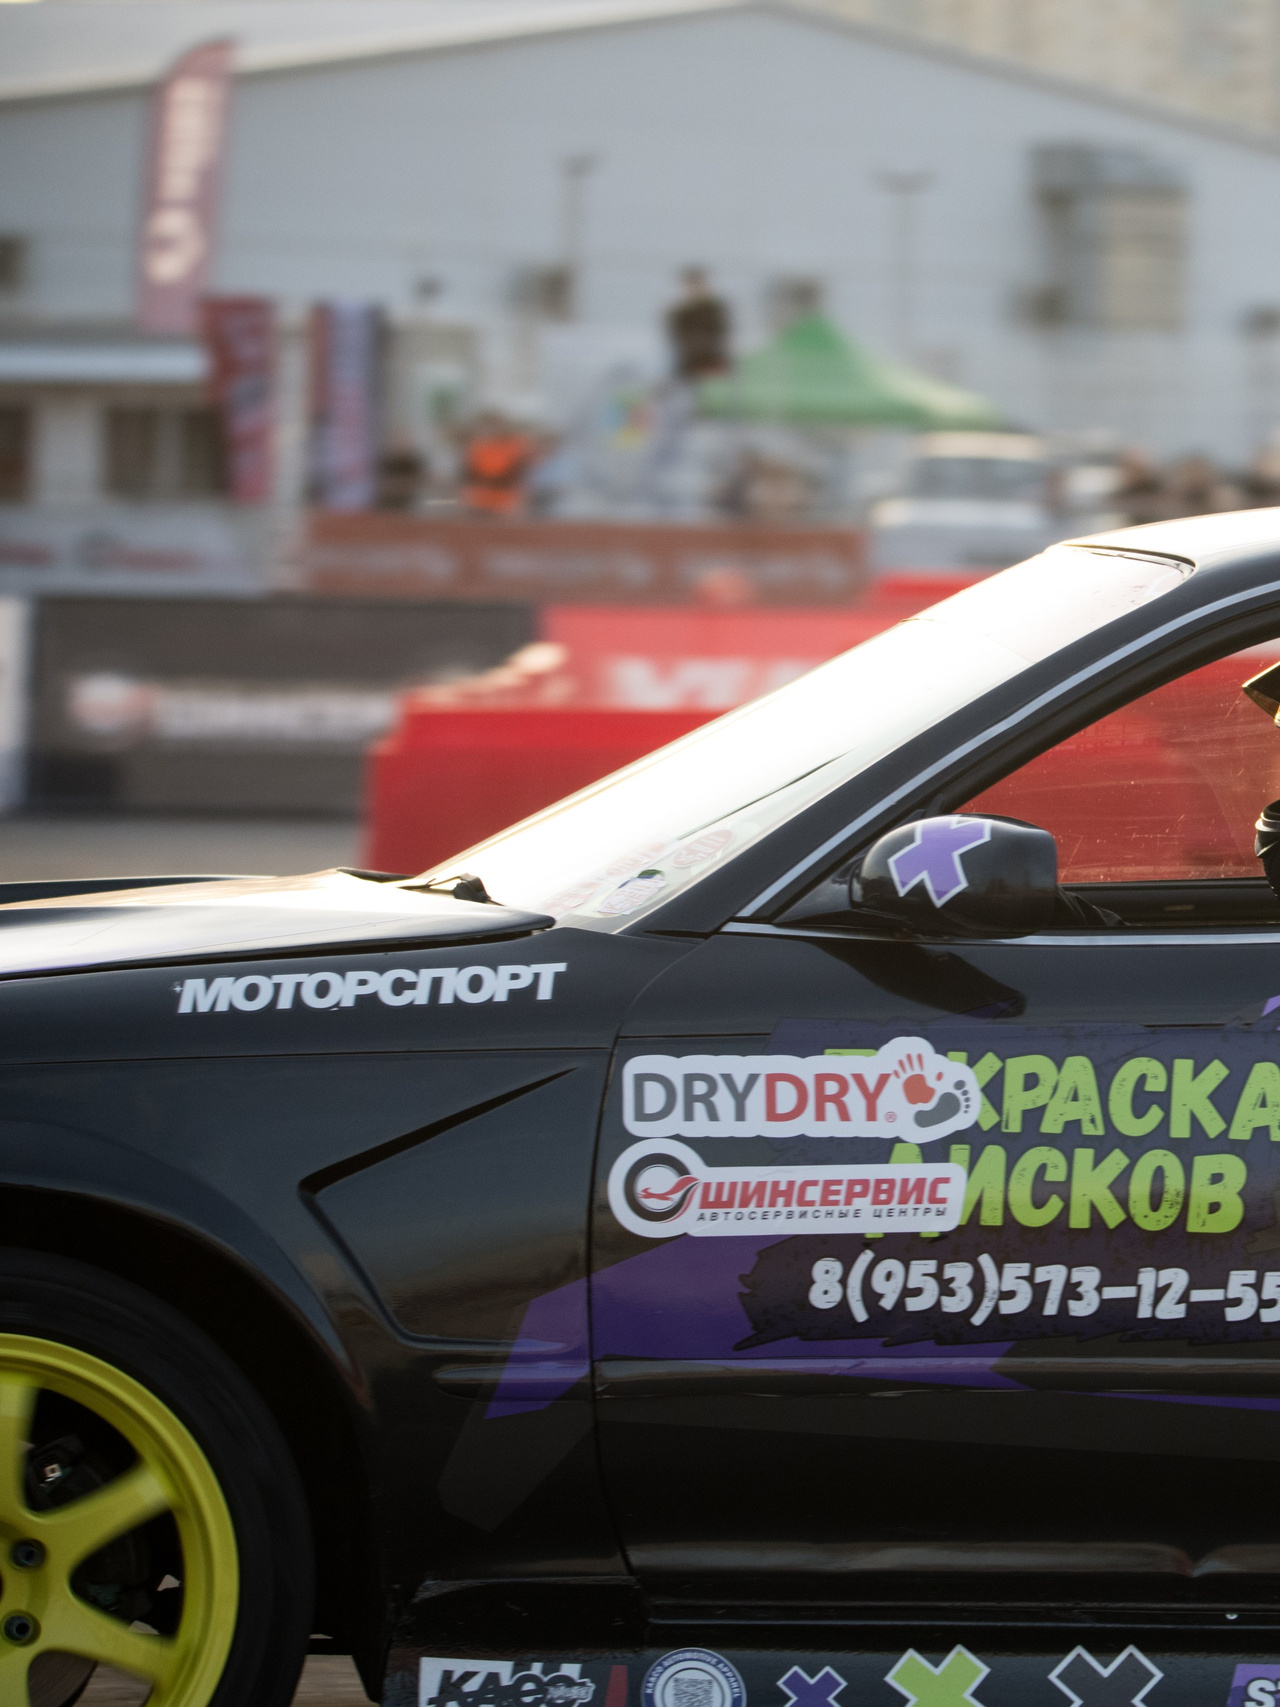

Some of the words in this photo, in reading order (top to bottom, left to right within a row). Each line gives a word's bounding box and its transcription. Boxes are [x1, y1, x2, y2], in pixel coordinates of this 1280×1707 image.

[178, 962, 568, 1014] МОТОРСПОРТ
[697, 1176, 952, 1210] ШИНСЕРВИС
[697, 1207, 862, 1222] АВТОСЕРВИСНЫЕ
[873, 1206, 948, 1219] ЦЕНТРЫ
